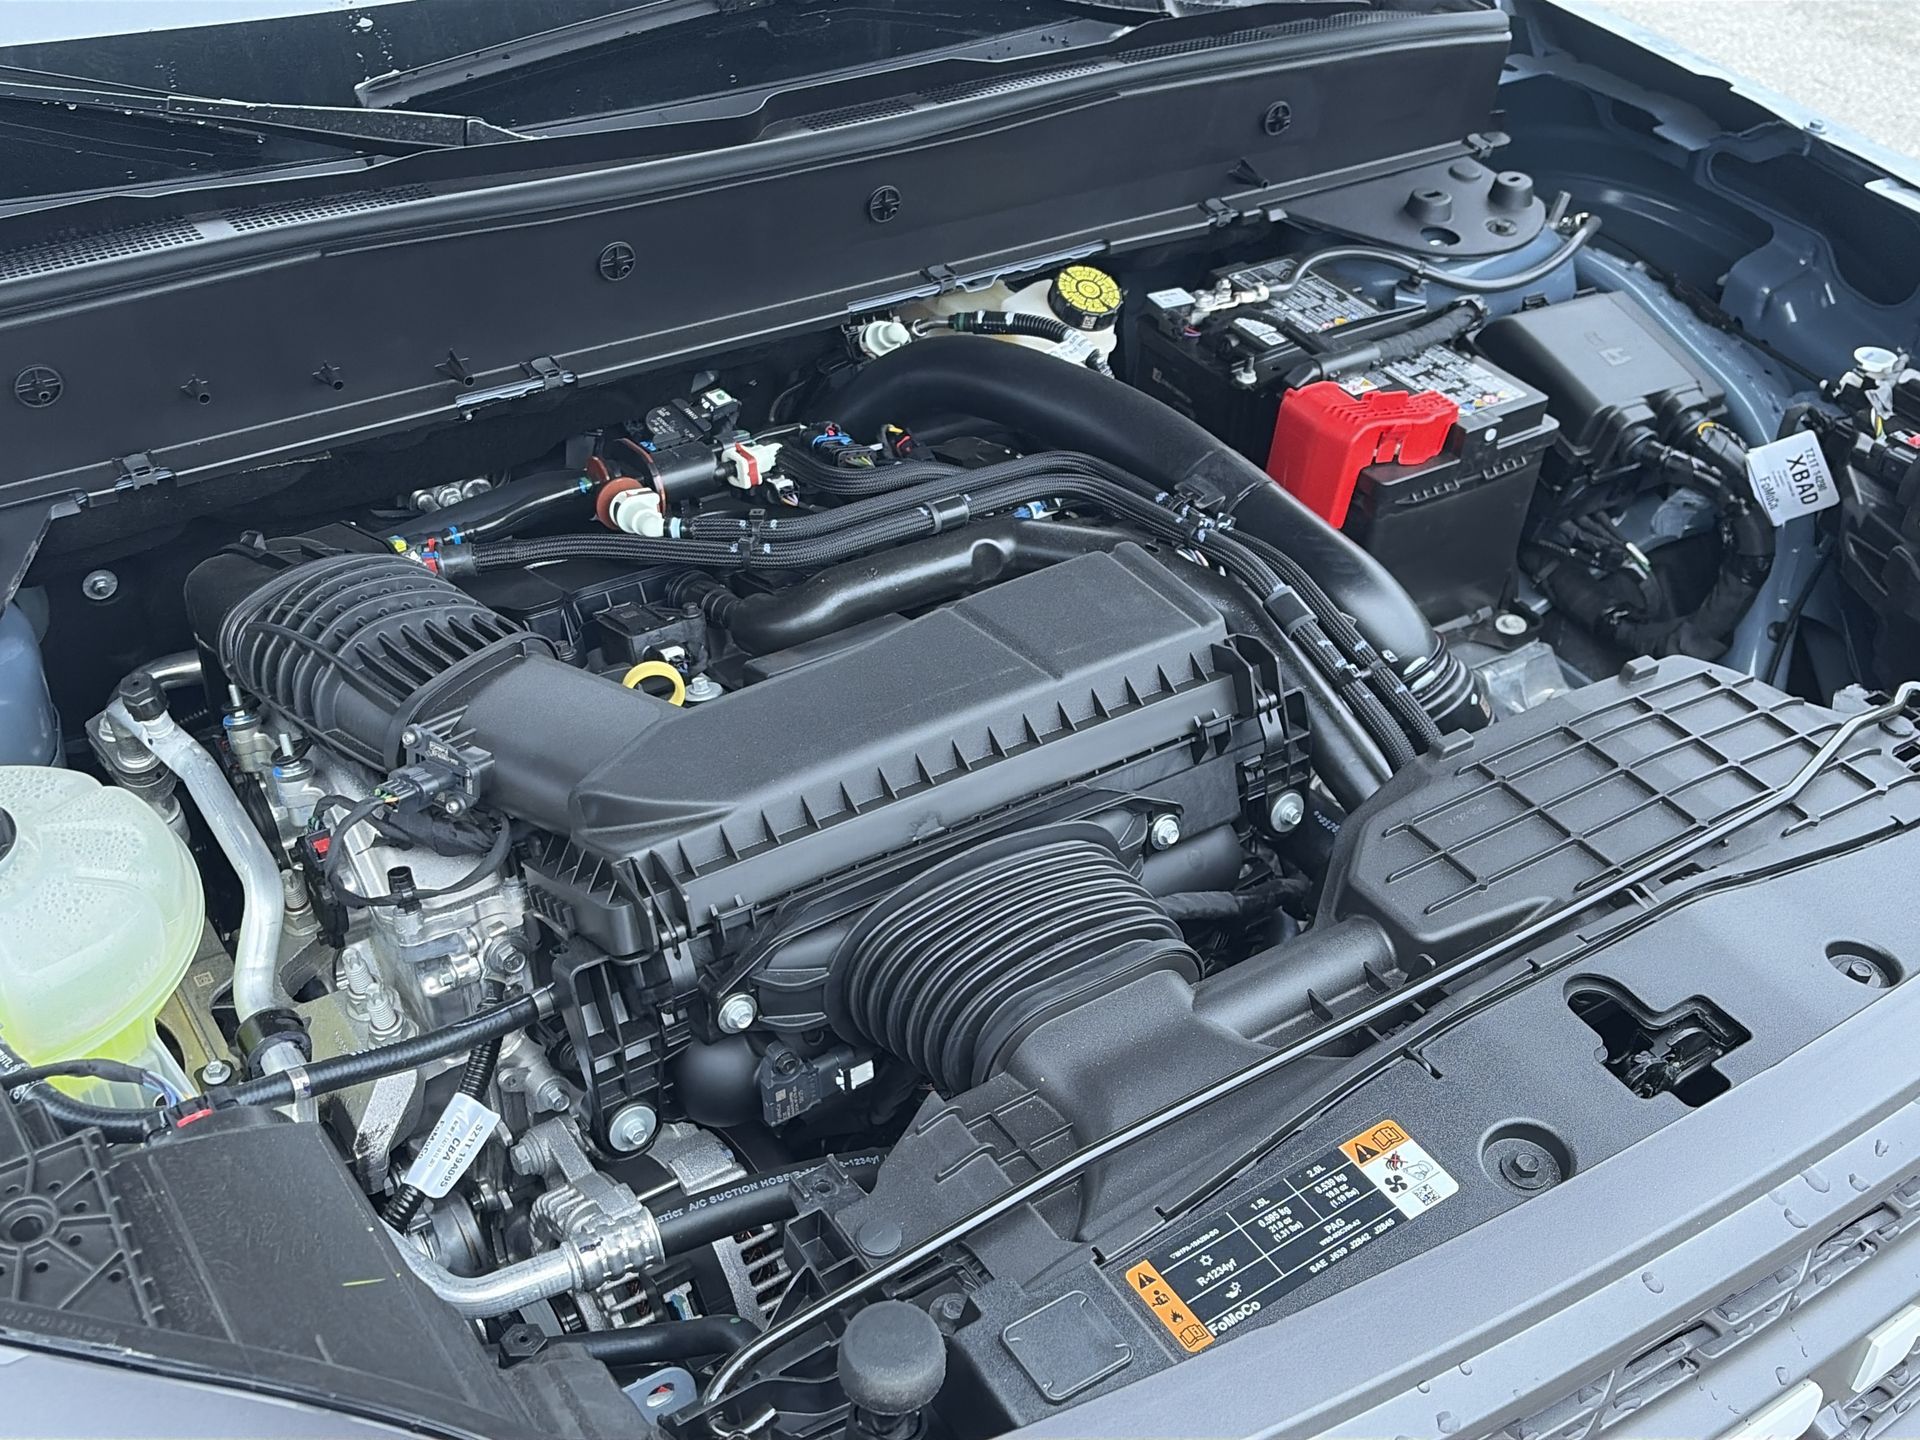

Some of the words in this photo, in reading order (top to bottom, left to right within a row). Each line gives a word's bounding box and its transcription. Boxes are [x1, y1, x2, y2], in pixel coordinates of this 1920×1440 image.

[1786, 454, 1819, 505] XBAD
[442, 1137, 461, 1161] CBA
[440, 1151, 467, 1188] 19A095
[1306, 1164, 1327, 1178] 2.0L
[688, 1198, 707, 1212] A/C
[709, 1182, 759, 1206] SUCTION
[761, 1173, 791, 1189] HOSE
[1314, 1177, 1337, 1194] 0.539
[1333, 1173, 1348, 1183] kg
[1325, 1187, 1341, 1199] 19.0
[1339, 1183, 1349, 1192] oz
[1344, 1187, 1360, 1199] lbs)
[1250, 1197, 1271, 1211] 1.5L
[1258, 1210, 1281, 1228] 0.595
[1278, 1206, 1292, 1216] kg
[1268, 1220, 1284, 1234] 21.0
[1282, 1216, 1293, 1225] oz
[1288, 1220, 1304, 1233] lbs)
[1323, 1217, 1346, 1234] PAG
[1309, 1258, 1329, 1273] SAE
[1329, 1246, 1348, 1262] J639
[1349, 1232, 1372, 1250] J2842
[1373, 1217, 1396, 1235] J2845
[1196, 1257, 1237, 1287] R-1234yf
[1207, 1301, 1261, 1336] FoMoCo
